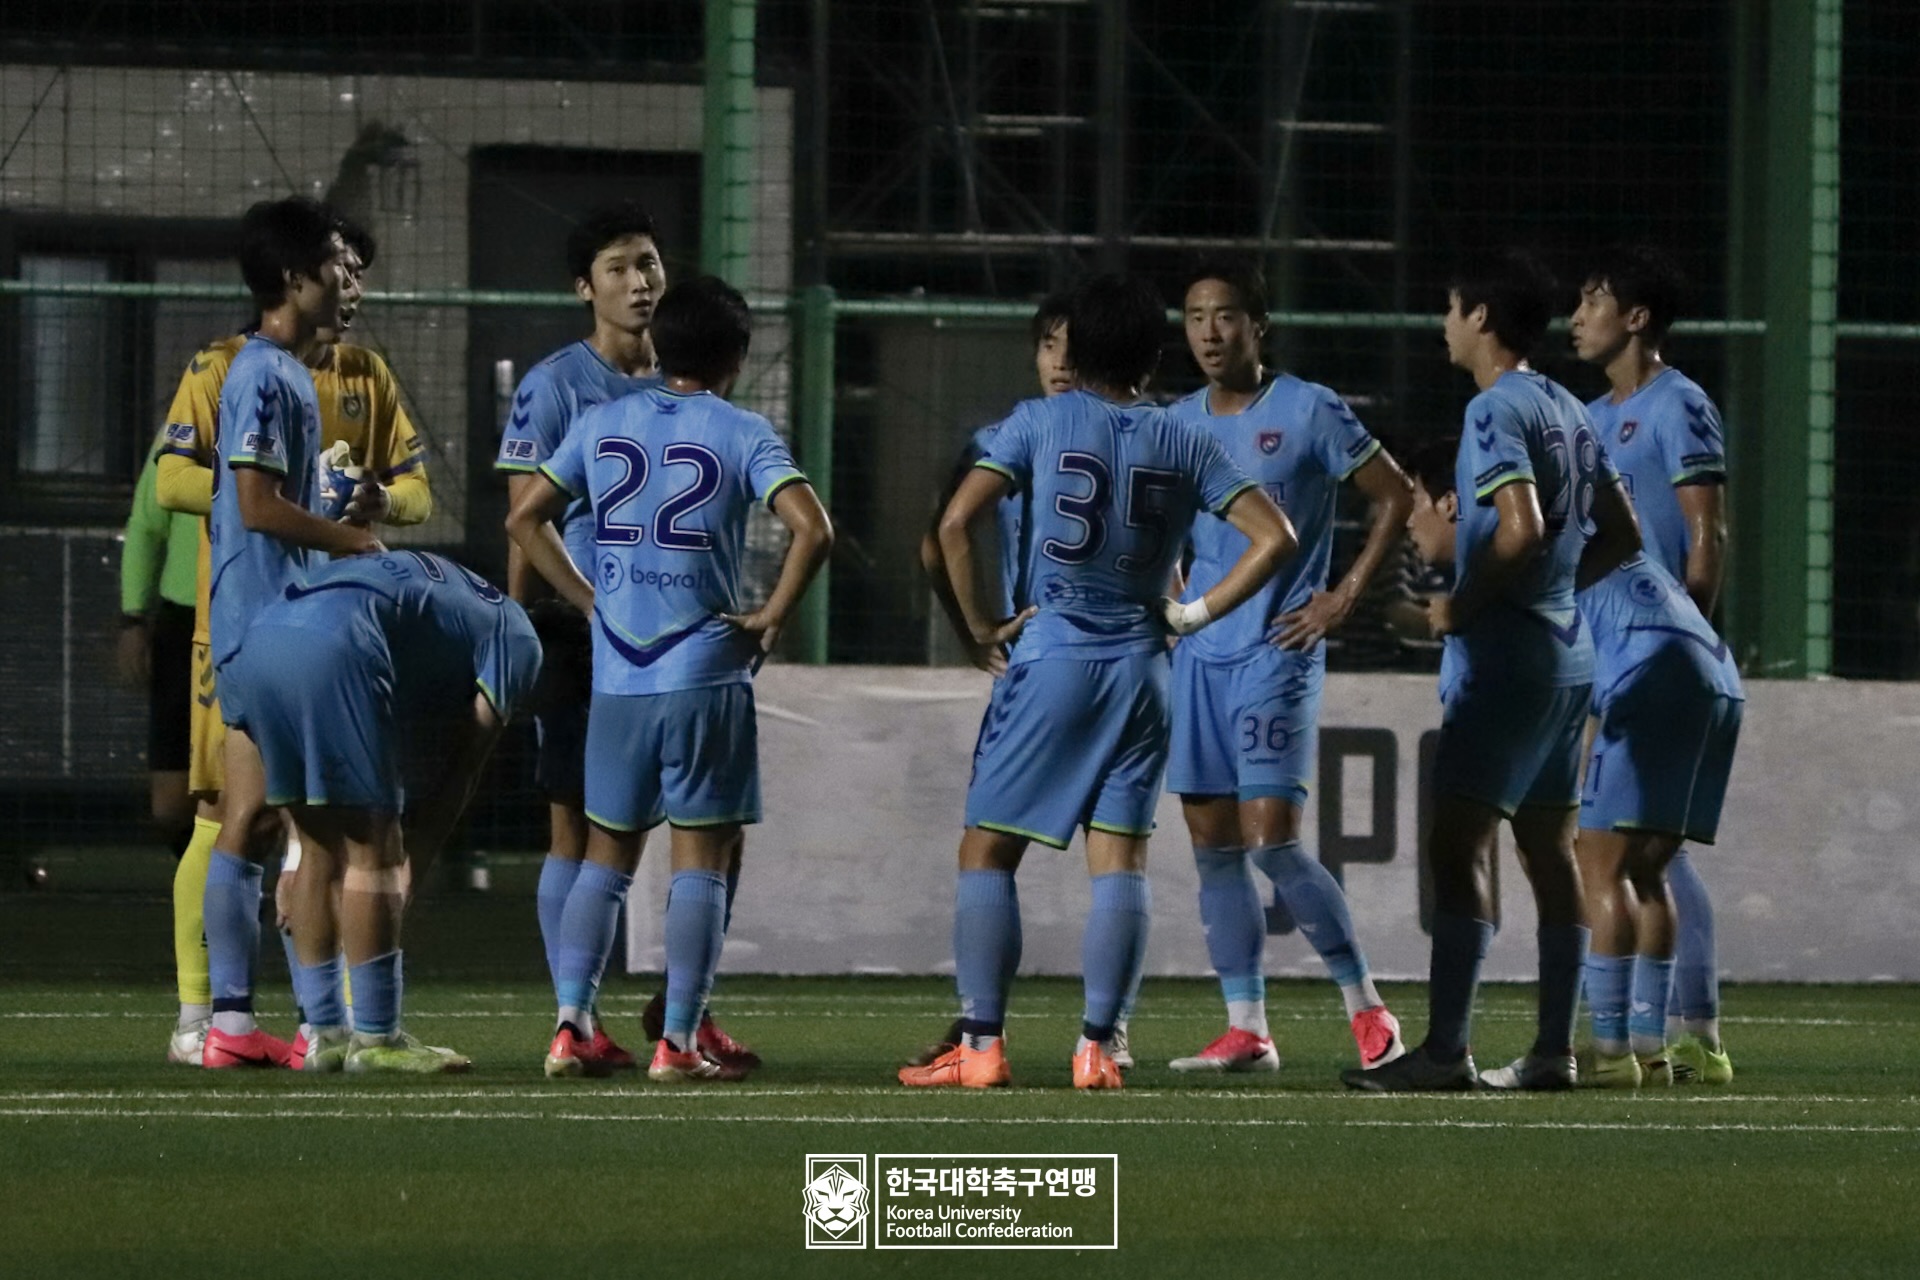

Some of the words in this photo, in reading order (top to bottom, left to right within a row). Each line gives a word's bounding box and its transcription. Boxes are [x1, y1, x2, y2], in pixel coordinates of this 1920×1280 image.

[596, 436, 723, 551] 22
[1042, 450, 1184, 577] 35
[1542, 425, 1598, 536] 28
[1242, 715, 1290, 752] 36
